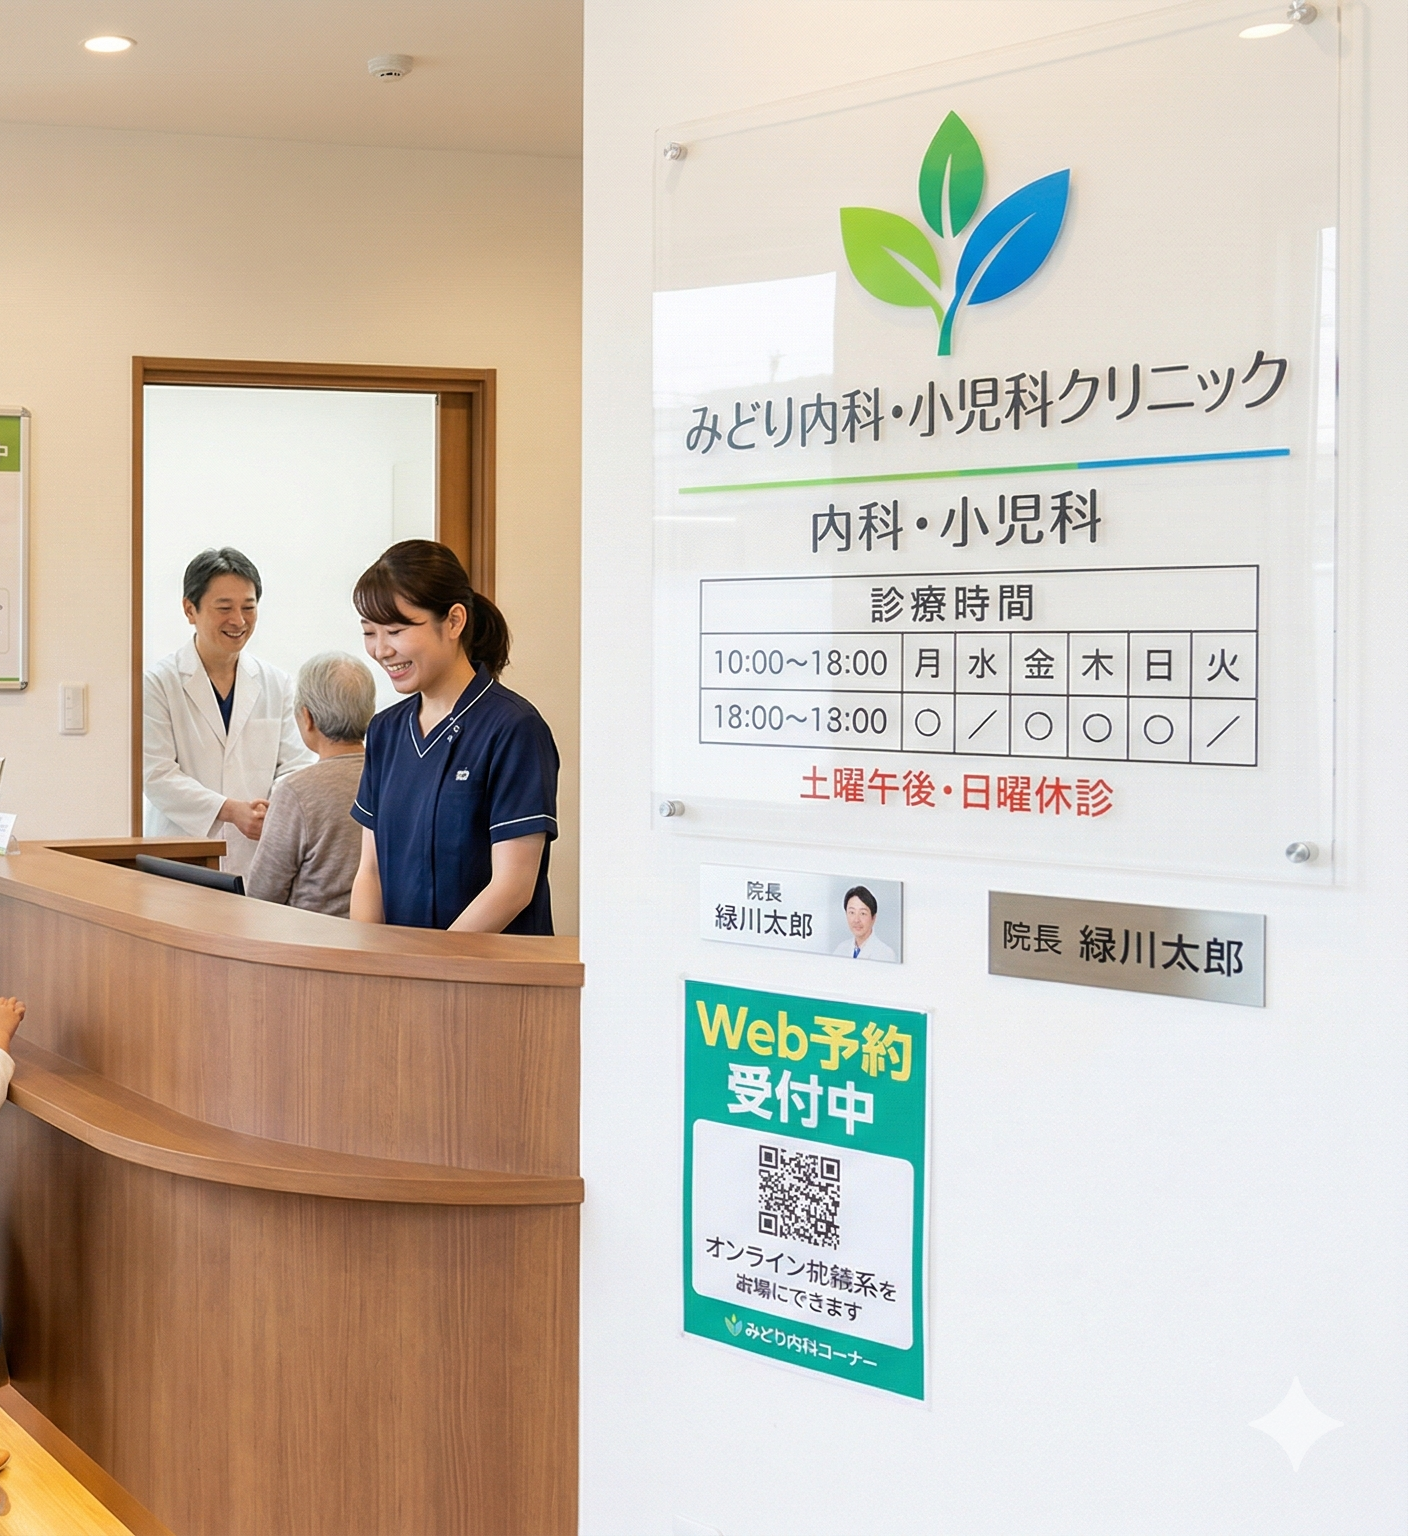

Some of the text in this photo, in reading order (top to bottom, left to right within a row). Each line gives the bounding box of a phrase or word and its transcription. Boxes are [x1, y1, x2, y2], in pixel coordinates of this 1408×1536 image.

[685, 350, 1289, 455] みどり内科・小児科クリニック
[811, 488, 1103, 553] 内科・小児科
[870, 584, 1035, 624] 診療時間
[914, 649, 941, 679] 月
[968, 649, 999, 679] 水
[1023, 648, 1056, 679] 金
[1081, 648, 1115, 681] 木
[1145, 649, 1174, 681] 日
[1206, 649, 1242, 682] 火
[800, 765, 1114, 817] 土曜午後・日曜休診
[746, 881, 782, 903] 院長
[715, 903, 813, 939] 緑川太郎
[1003, 920, 1245, 978] 院長 緑川太郎
[696, 1000, 912, 1082] Web予約
[727, 1062, 874, 1136] 受付中
